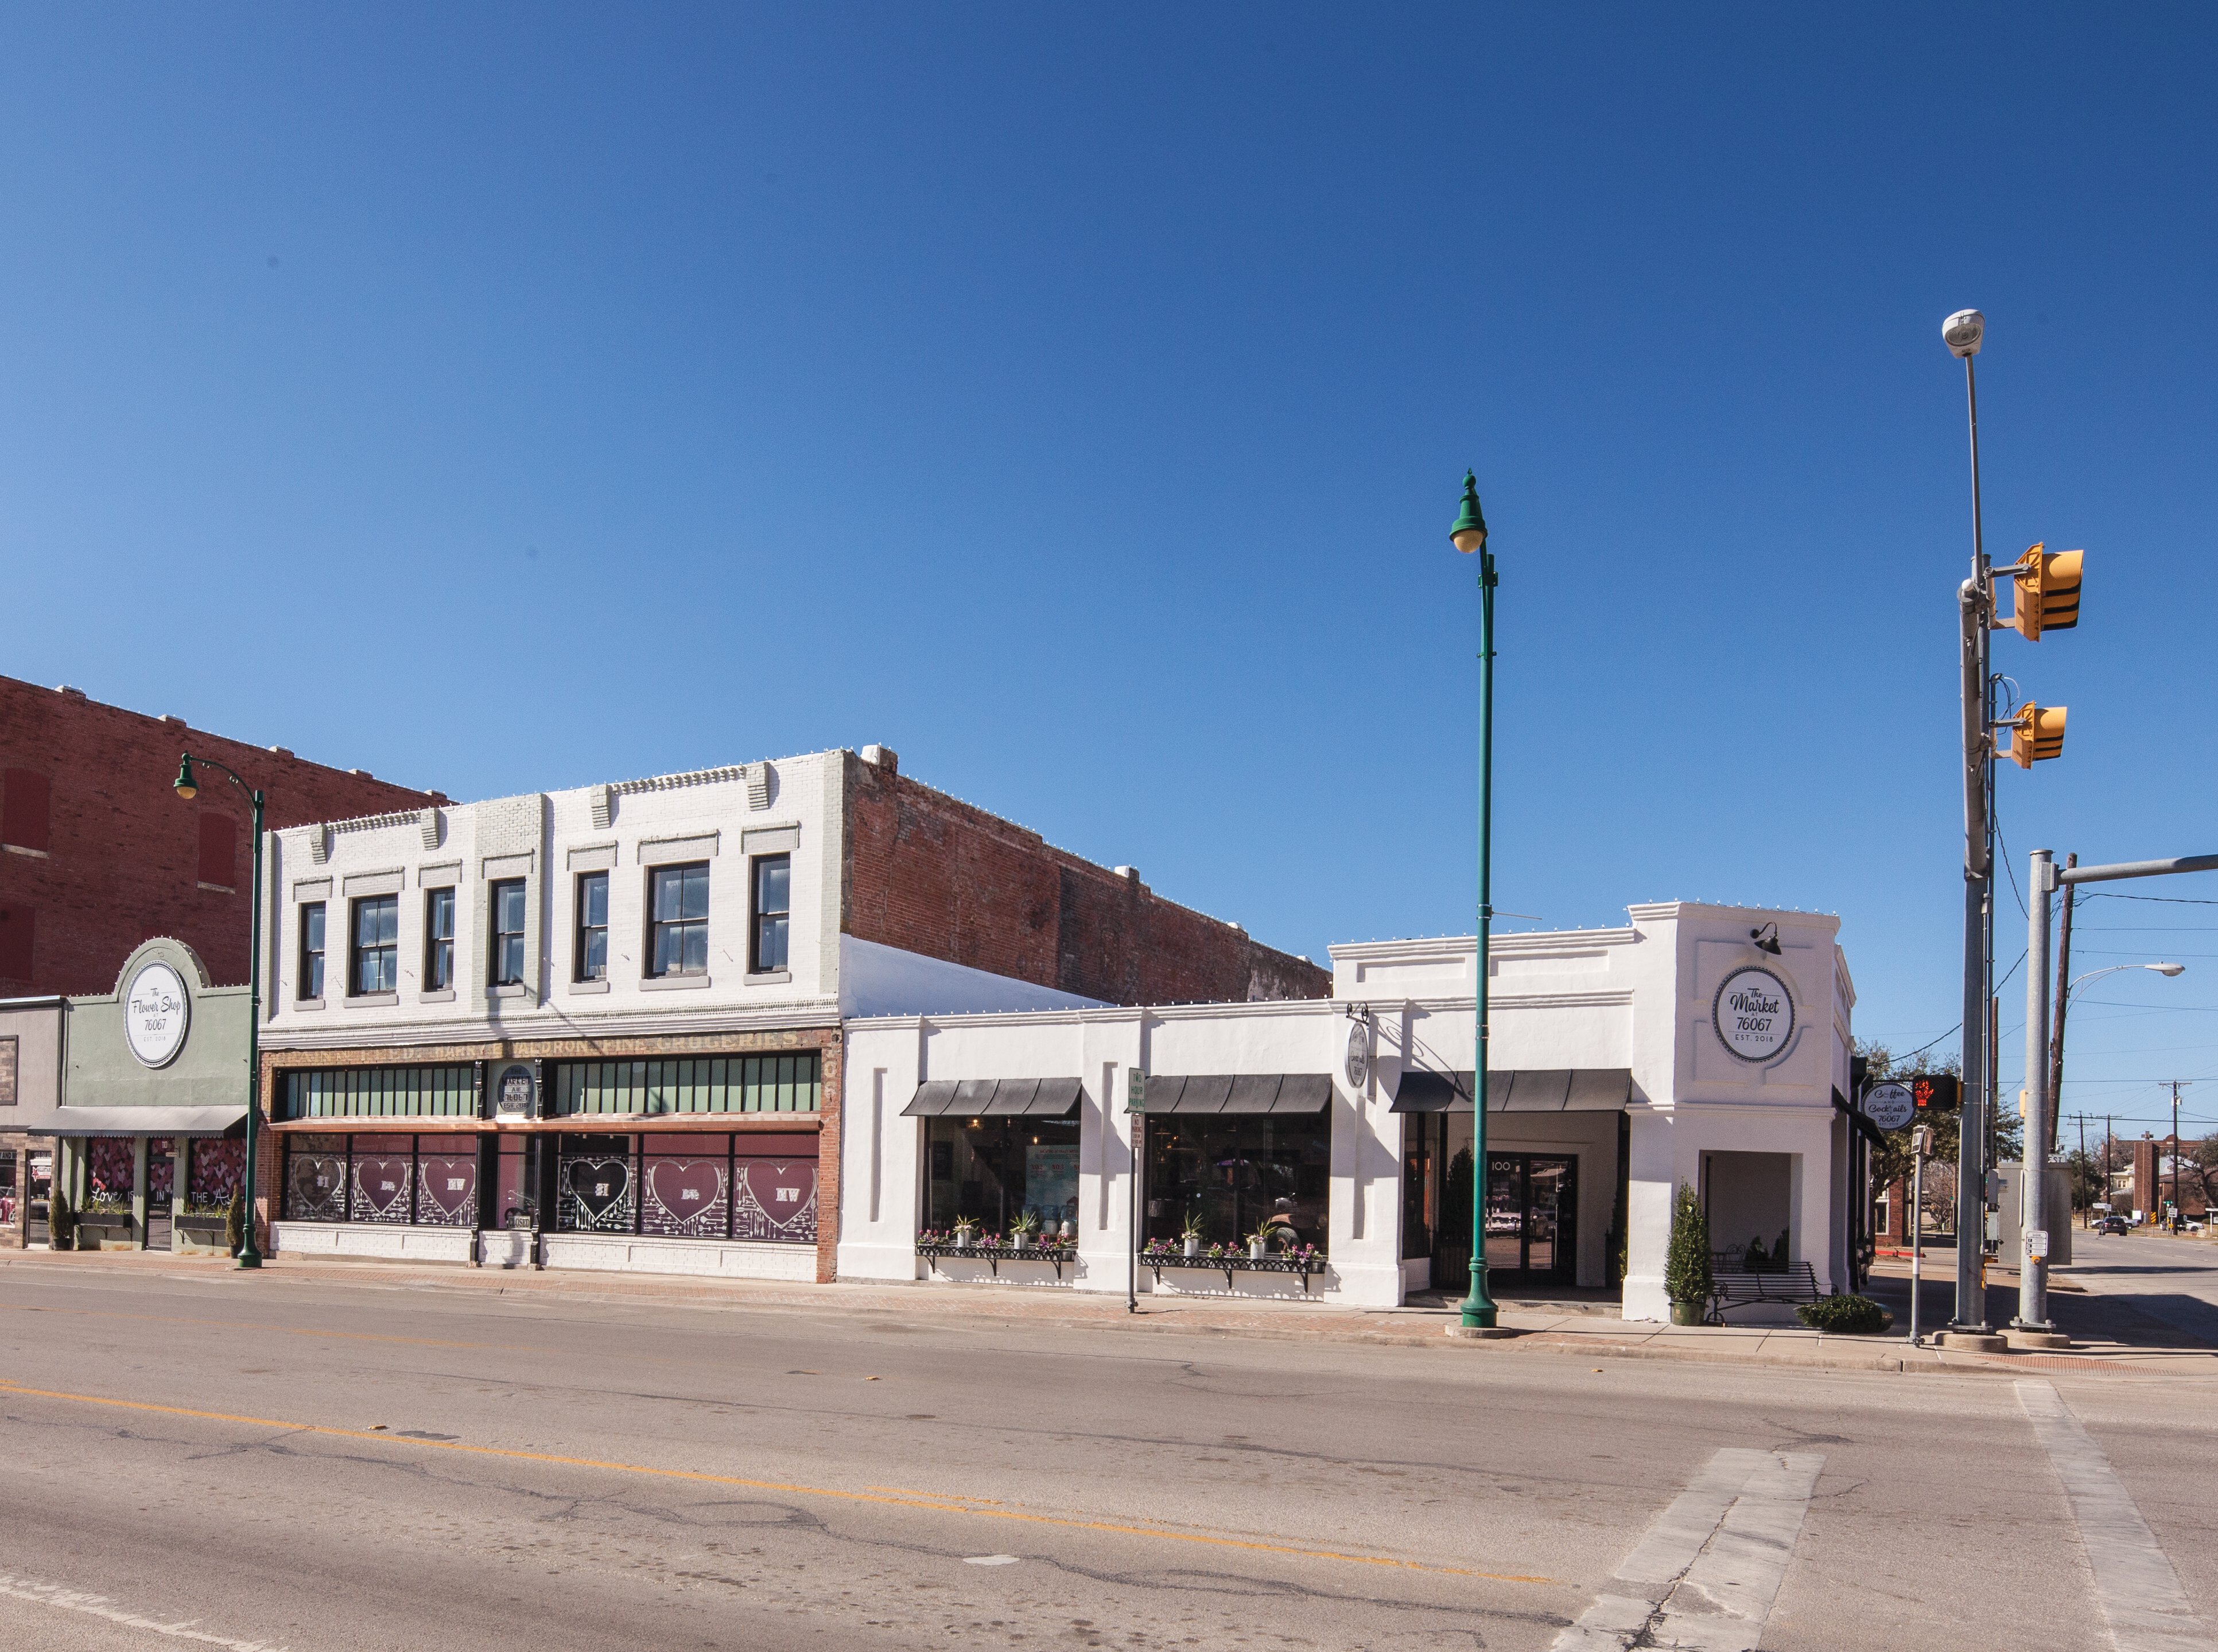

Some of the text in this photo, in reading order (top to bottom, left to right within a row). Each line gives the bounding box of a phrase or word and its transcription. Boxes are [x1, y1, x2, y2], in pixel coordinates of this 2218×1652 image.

[150, 988, 160, 997] The
[1747, 988, 1763, 998] The
[131, 996, 181, 1015] Flower Shop
[1730, 993, 1780, 1014] Market
[145, 1019, 166, 1031] 76067
[1737, 1017, 1772, 1031] 76067
[502, 1076, 530, 1085] MARKET
[1133, 1073, 1141, 1083] TWO
[1131, 1086, 1143, 1095] HOUR
[1129, 1098, 1144, 1107] PARKING
[1492, 1161, 1510, 1171] 100
[90, 1187, 122, 1203] Love
[157, 1191, 164, 1201] IN
[191, 1191, 208, 1203] THE
[508, 1218, 529, 1227] CLOSED
